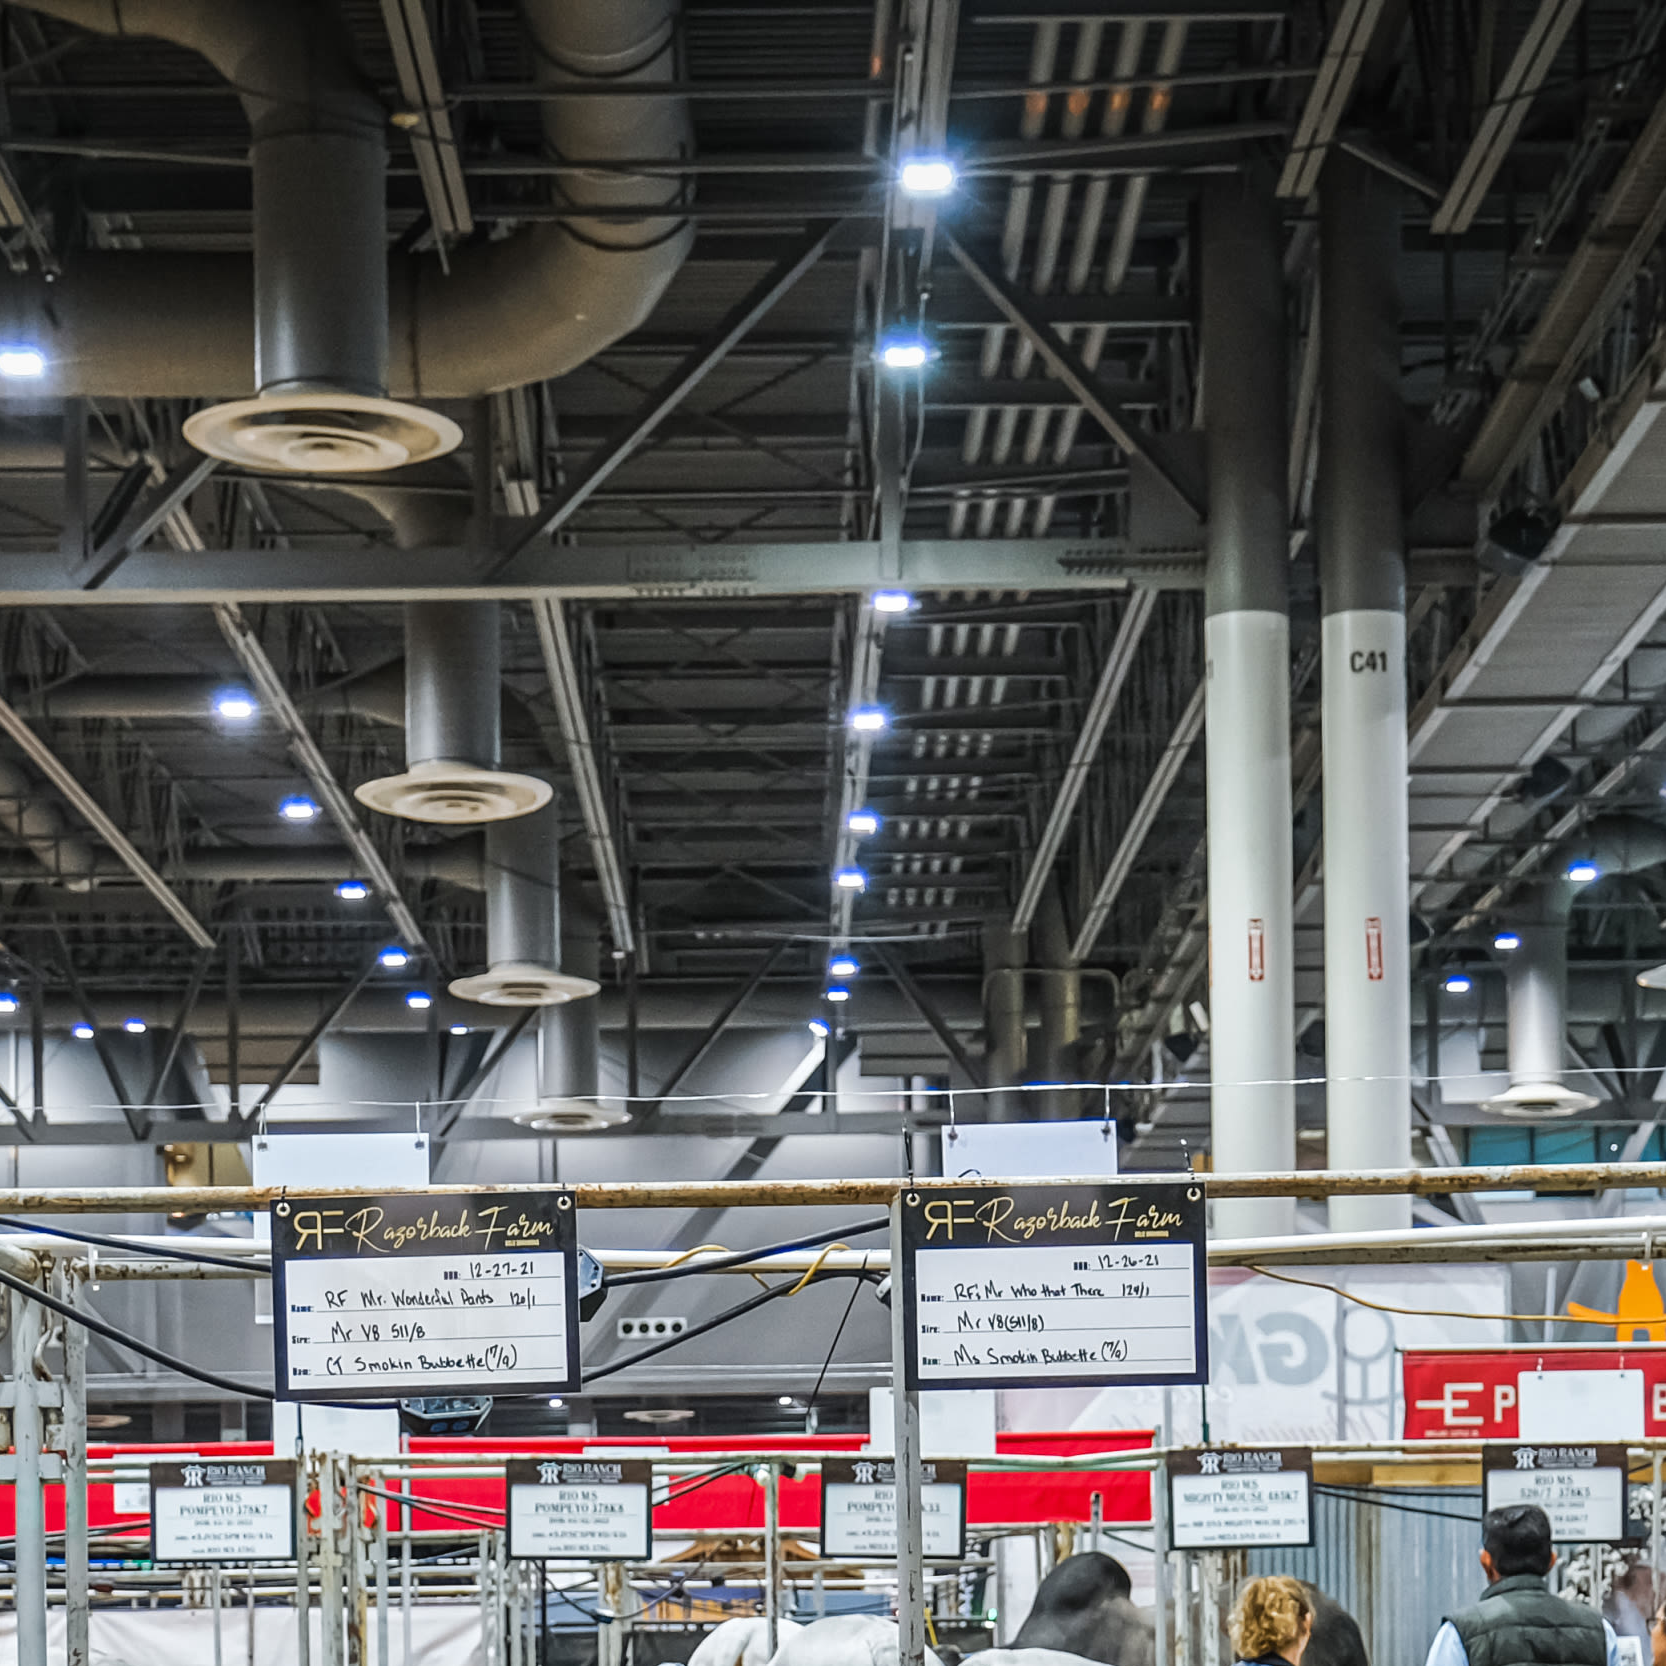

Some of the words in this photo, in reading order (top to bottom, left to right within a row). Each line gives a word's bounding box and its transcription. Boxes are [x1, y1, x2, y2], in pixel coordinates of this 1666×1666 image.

[1350, 650, 1388, 673] C41
[345, 1206, 472, 1254] Razorback
[475, 1205, 554, 1251] Farm
[975, 1196, 1102, 1244] Razorback
[1105, 1197, 1183, 1241] Farm
[469, 1261, 534, 1279] 12-27-21
[1098, 1254, 1159, 1269] 12-26-21
[324, 1288, 349, 1309] RF
[390, 1288, 455, 1308] Wonderful
[459, 1288, 494, 1307] Pants
[984, 1279, 1003, 1299] Mr
[1010, 1284, 1038, 1298] Who
[1040, 1283, 1067, 1297] that
[1071, 1283, 1105, 1298] There
[331, 1320, 351, 1344] Mr
[360, 1324, 380, 1340] V8
[391, 1322, 426, 1340] 511/8
[957, 1310, 982, 1333] Mr
[326, 1358, 344, 1376] CT
[354, 1355, 413, 1371] Smokin
[953, 1343, 981, 1366] Ms
[987, 1347, 1039, 1365] Smokin
[1041, 1347, 1097, 1364] Bubbette
